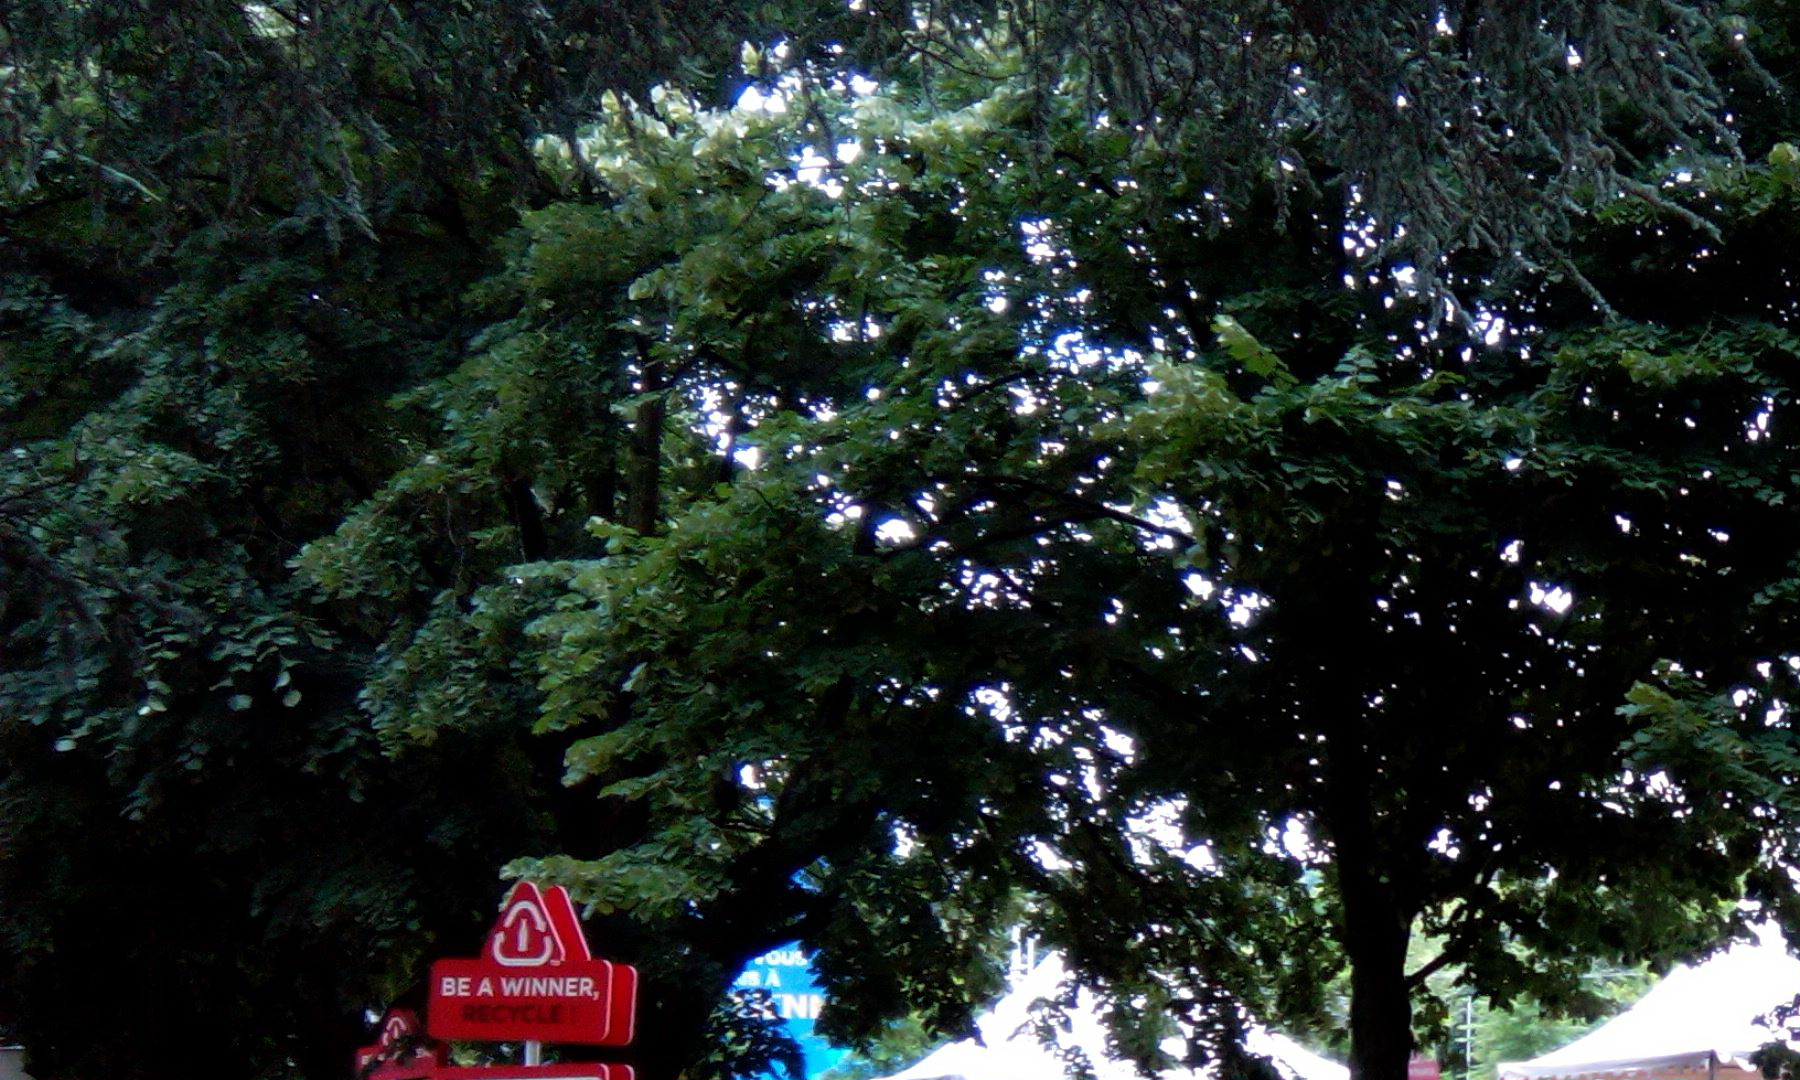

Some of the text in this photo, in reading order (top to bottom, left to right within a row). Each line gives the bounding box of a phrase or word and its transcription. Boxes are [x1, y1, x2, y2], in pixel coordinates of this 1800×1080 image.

[440, 977, 600, 1000] BE A WINNER,
[462, 1004, 561, 1024] RECYCLE
